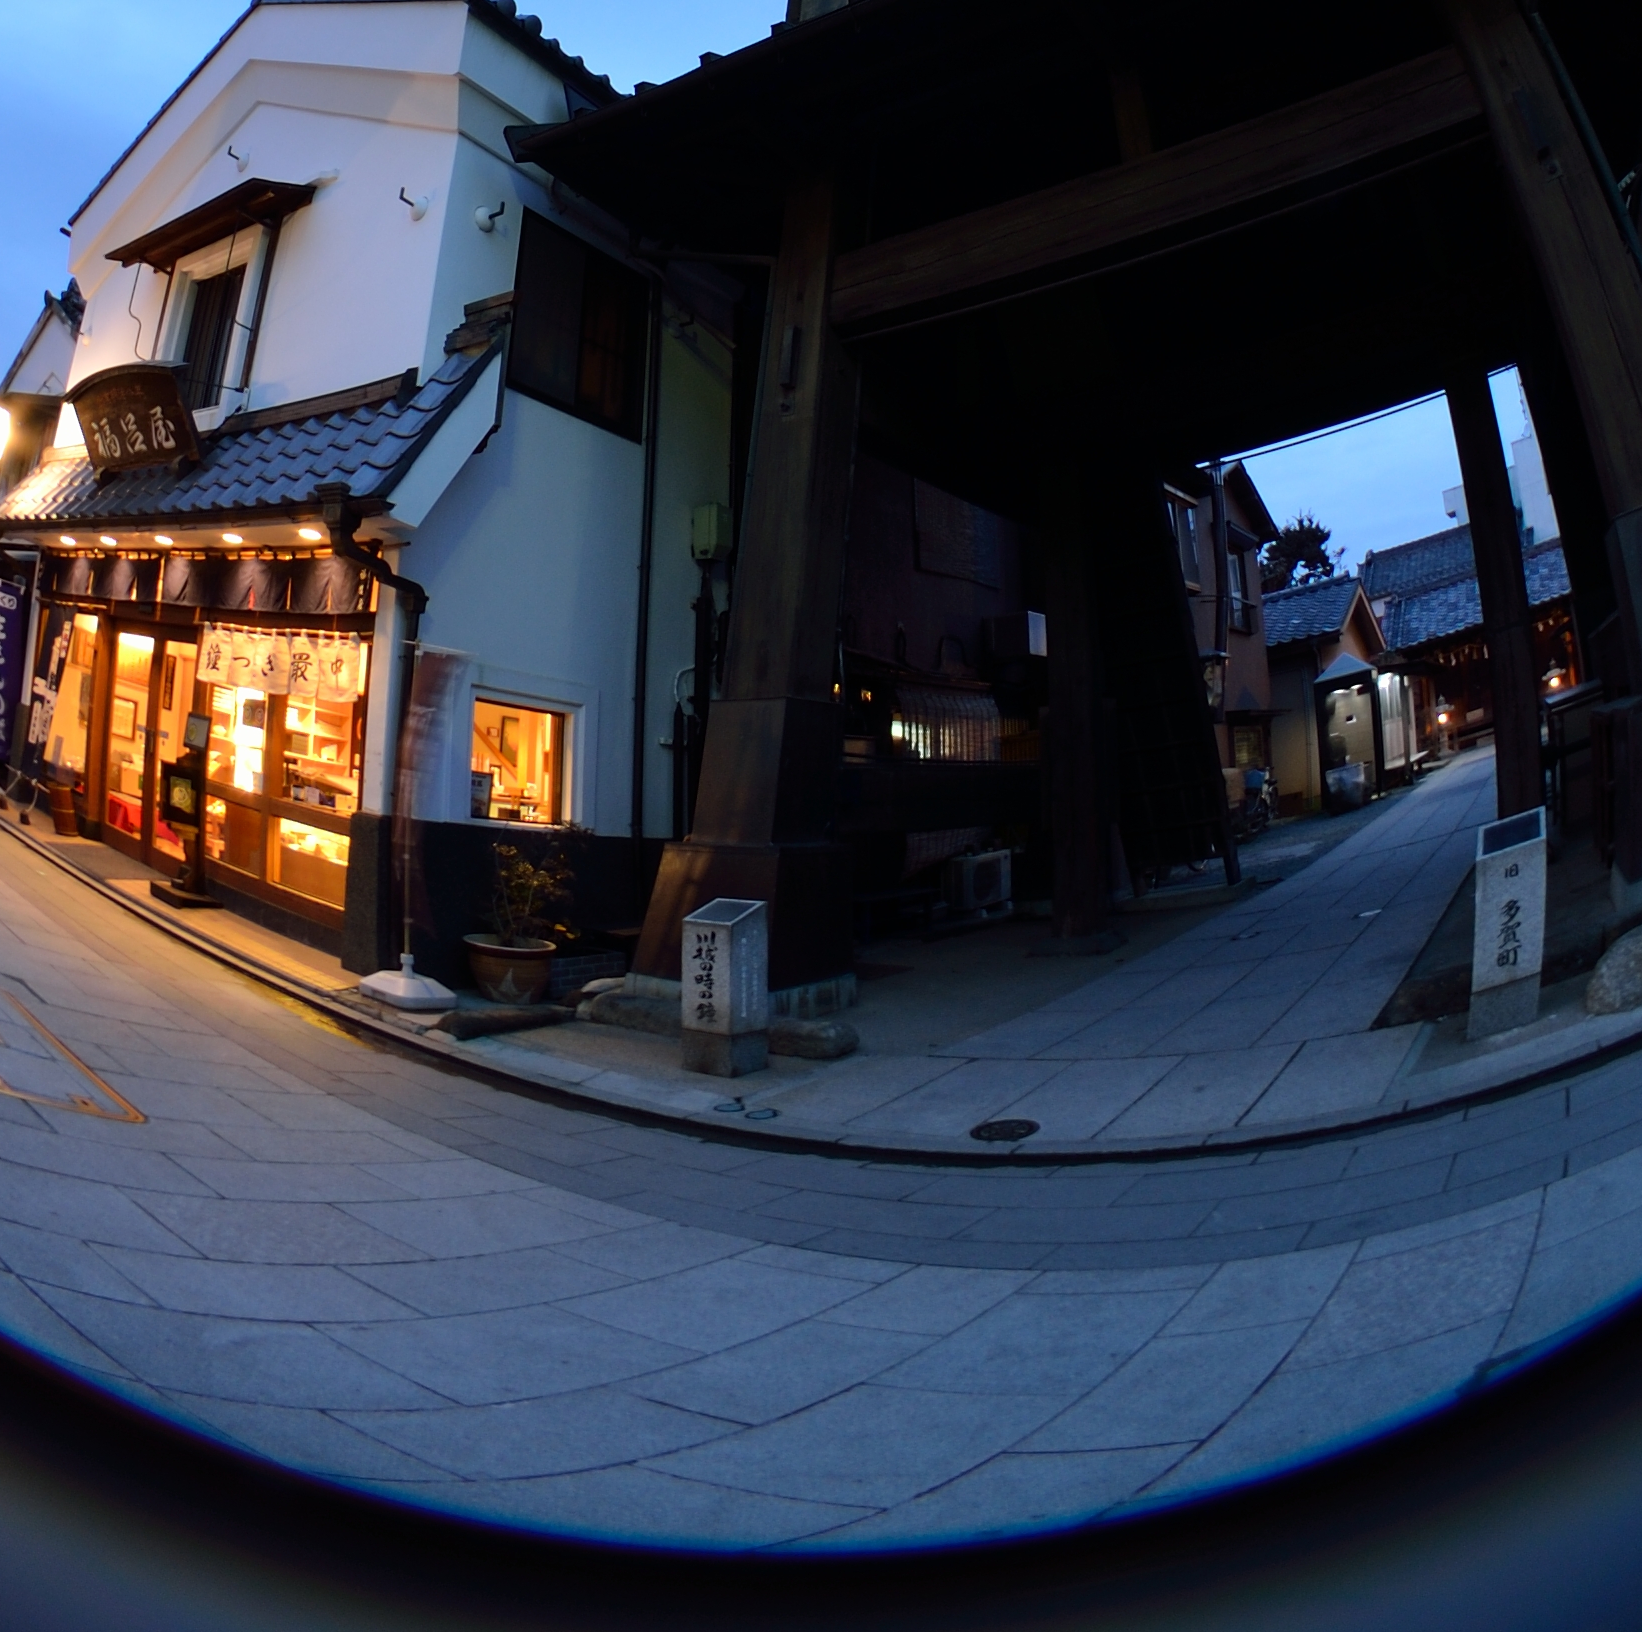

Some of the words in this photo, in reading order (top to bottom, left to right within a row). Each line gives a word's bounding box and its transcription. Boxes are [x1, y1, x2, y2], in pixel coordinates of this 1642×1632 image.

[91, 405, 176, 458] 福呂屋
[1504, 863, 1519, 878] 旧
[1496, 899, 1522, 967] 多賀町
[692, 931, 718, 1024] 川越の時の鐘
